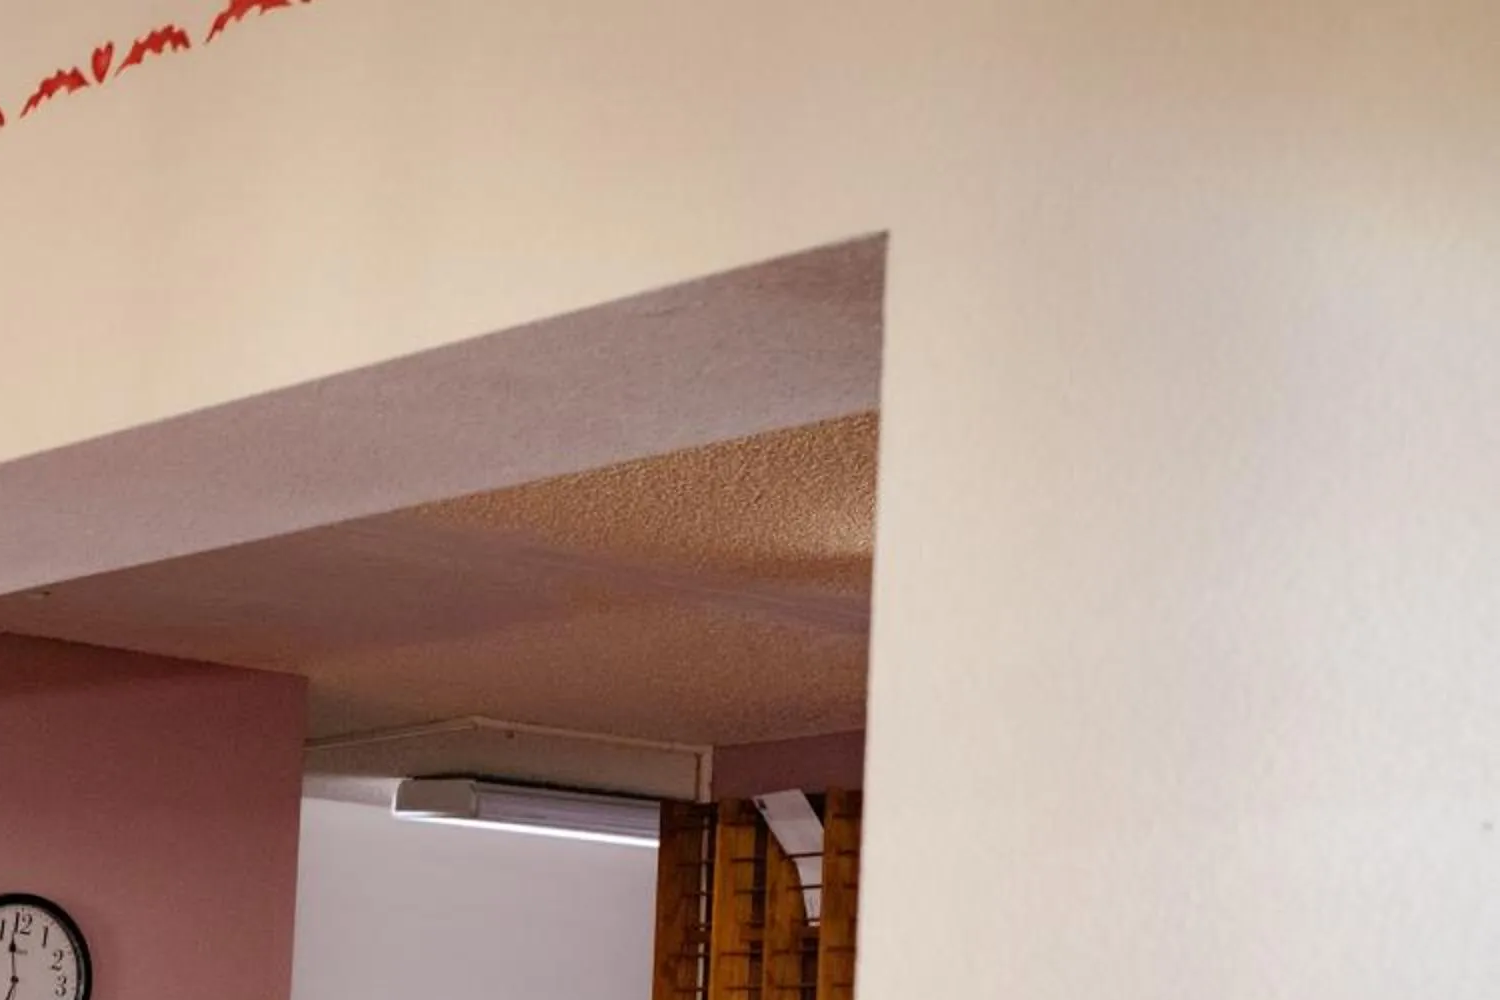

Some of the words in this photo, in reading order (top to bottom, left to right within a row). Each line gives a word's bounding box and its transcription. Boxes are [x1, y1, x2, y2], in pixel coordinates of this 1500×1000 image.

[14, 911, 33, 935] 12
[41, 925, 49, 948] 1
[50, 949, 65, 971] 2
[55, 975, 67, 997] 3
